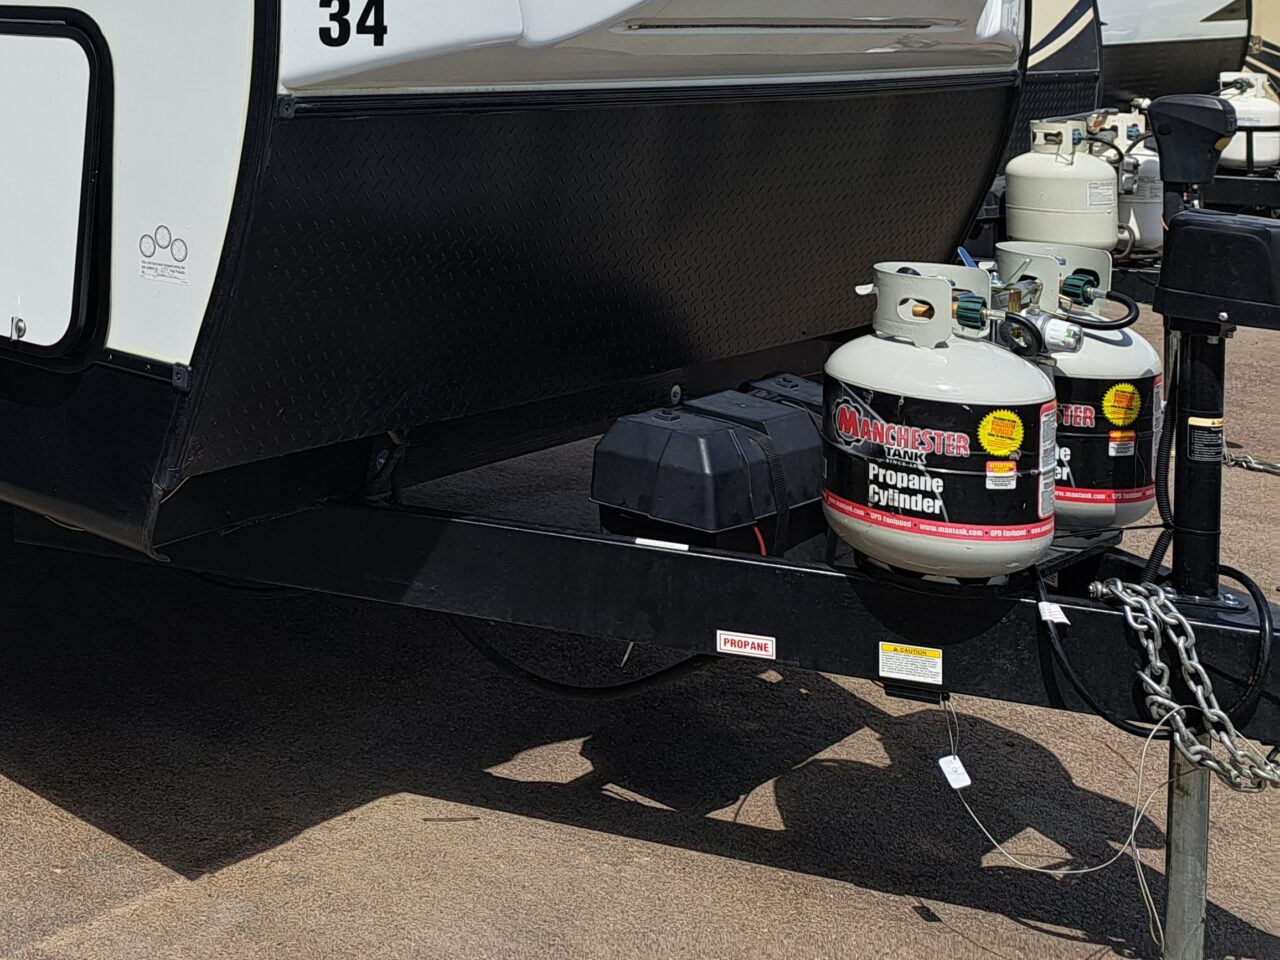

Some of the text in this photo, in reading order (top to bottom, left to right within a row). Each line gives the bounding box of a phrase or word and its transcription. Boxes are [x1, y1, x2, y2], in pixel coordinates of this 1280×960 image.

[837, 404, 970, 457] MANCHESTER
[884, 446, 927, 464] TANK
[869, 462, 944, 493] Propane
[869, 484, 942, 515] Cylinder
[919, 523, 983, 536] www.mantank.com
[723, 637, 770, 652] PROPANE
[900, 647, 927, 656] CAUTION
